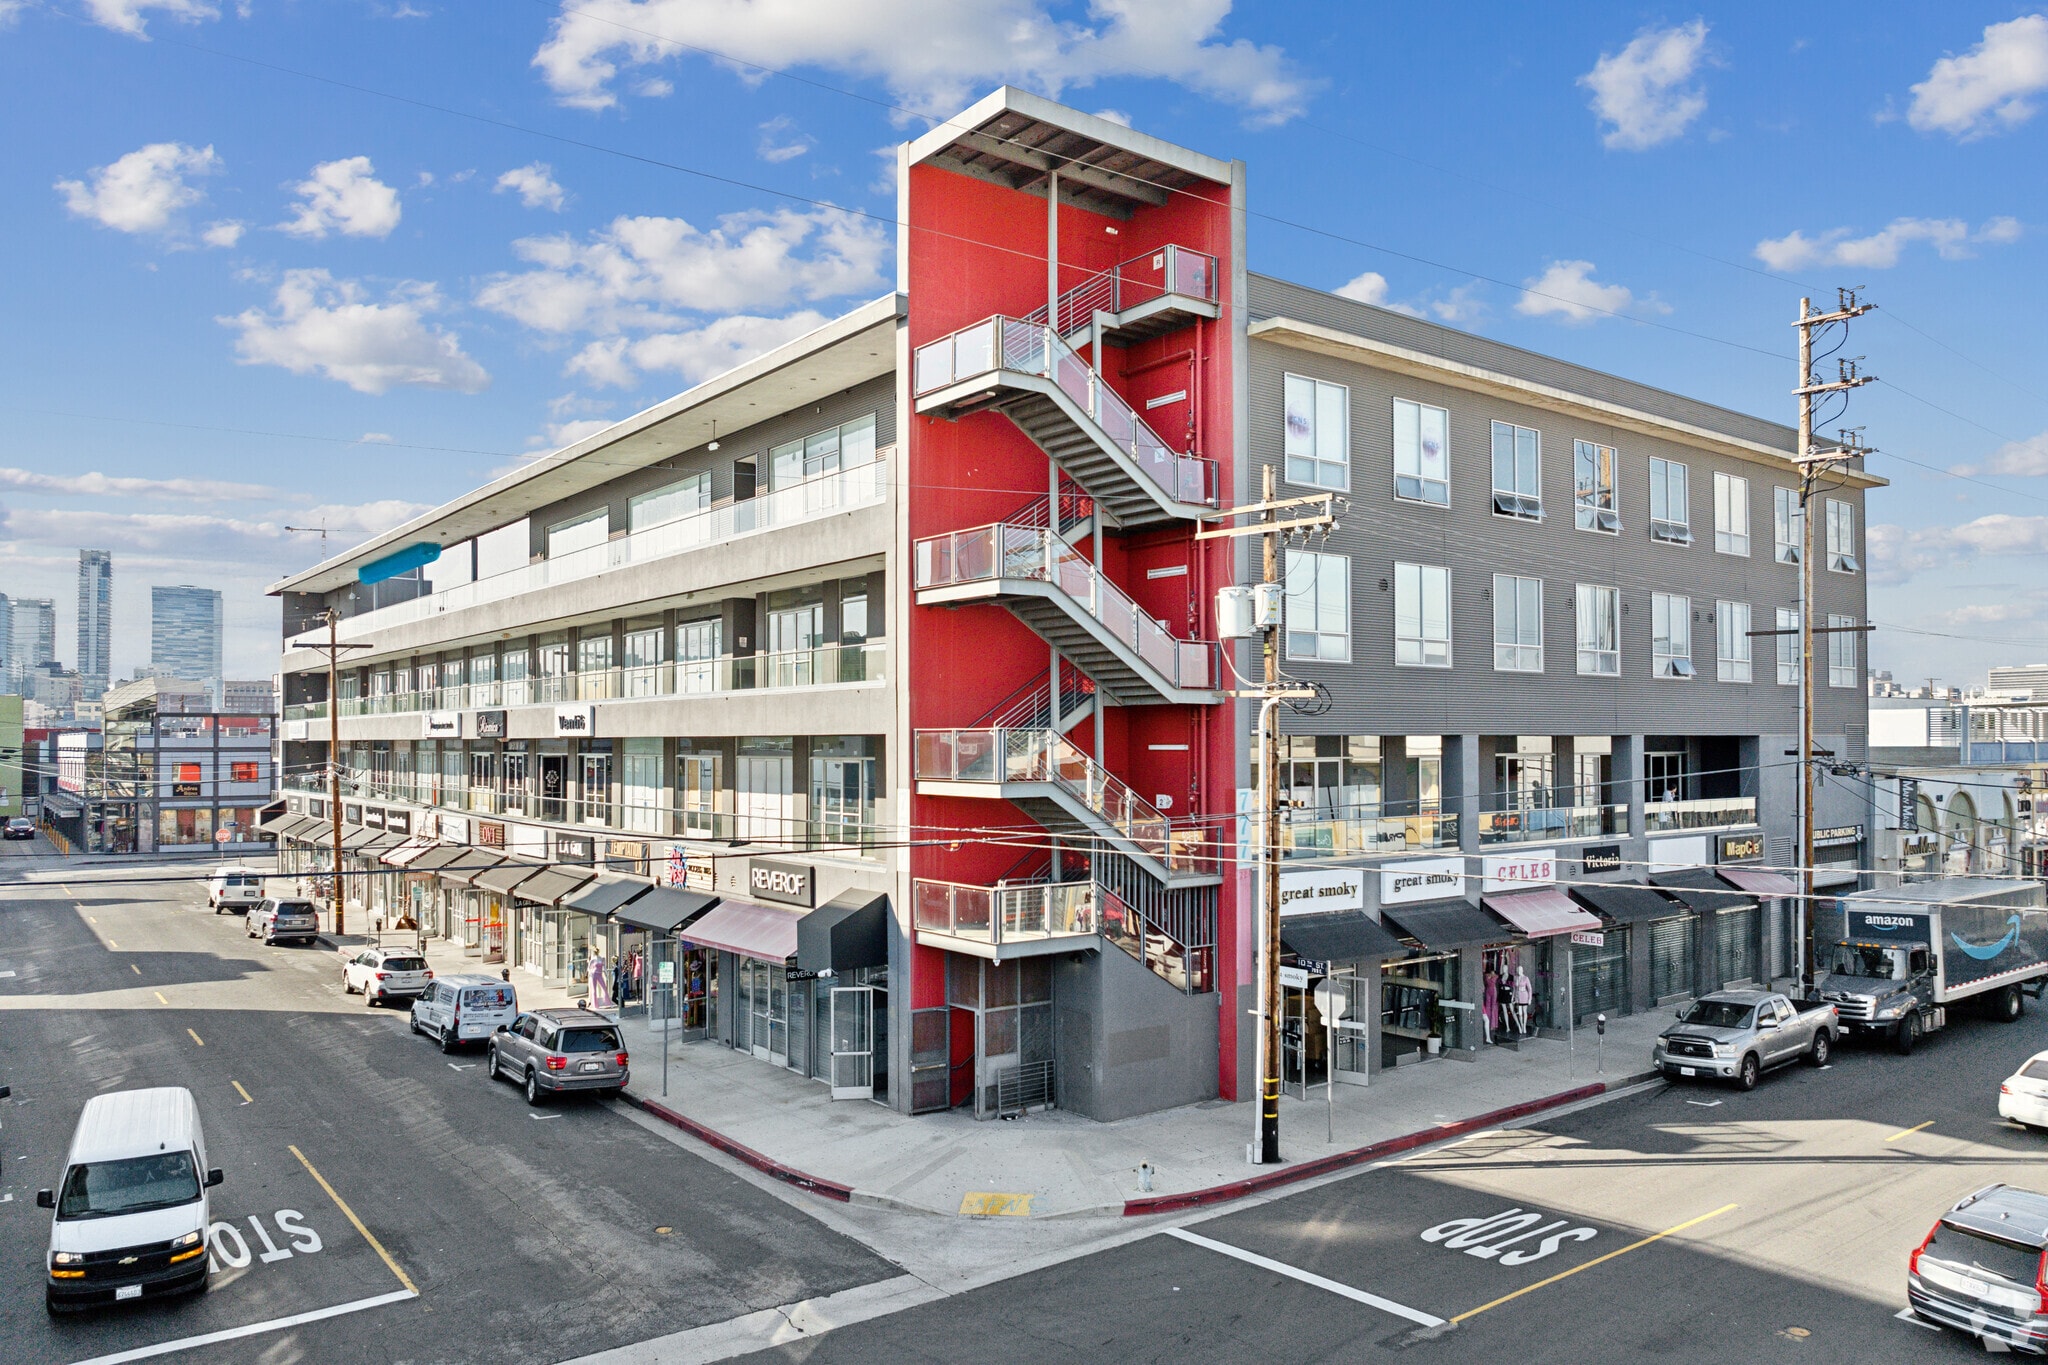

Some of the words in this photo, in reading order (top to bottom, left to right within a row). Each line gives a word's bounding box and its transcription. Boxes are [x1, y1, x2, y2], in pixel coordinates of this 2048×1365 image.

[1813, 830, 1830, 839] UBLIC
[1830, 826, 1856, 838] PARKING
[1586, 852, 1620, 869] Victoria
[751, 867, 806, 896] REVEROF
[1393, 874, 1422, 893] great
[1426, 869, 1460, 886] smoky
[1498, 862, 1551, 882] CELEB
[1281, 886, 1314, 905] great
[1318, 881, 1358, 899] smoky
[1865, 914, 1914, 927] amazon
[1572, 934, 1603, 945] CELEB
[787, 970, 816, 979] REVERO
[208, 1209, 323, 1274] STO
[1420, 1208, 1598, 1266] STOP
